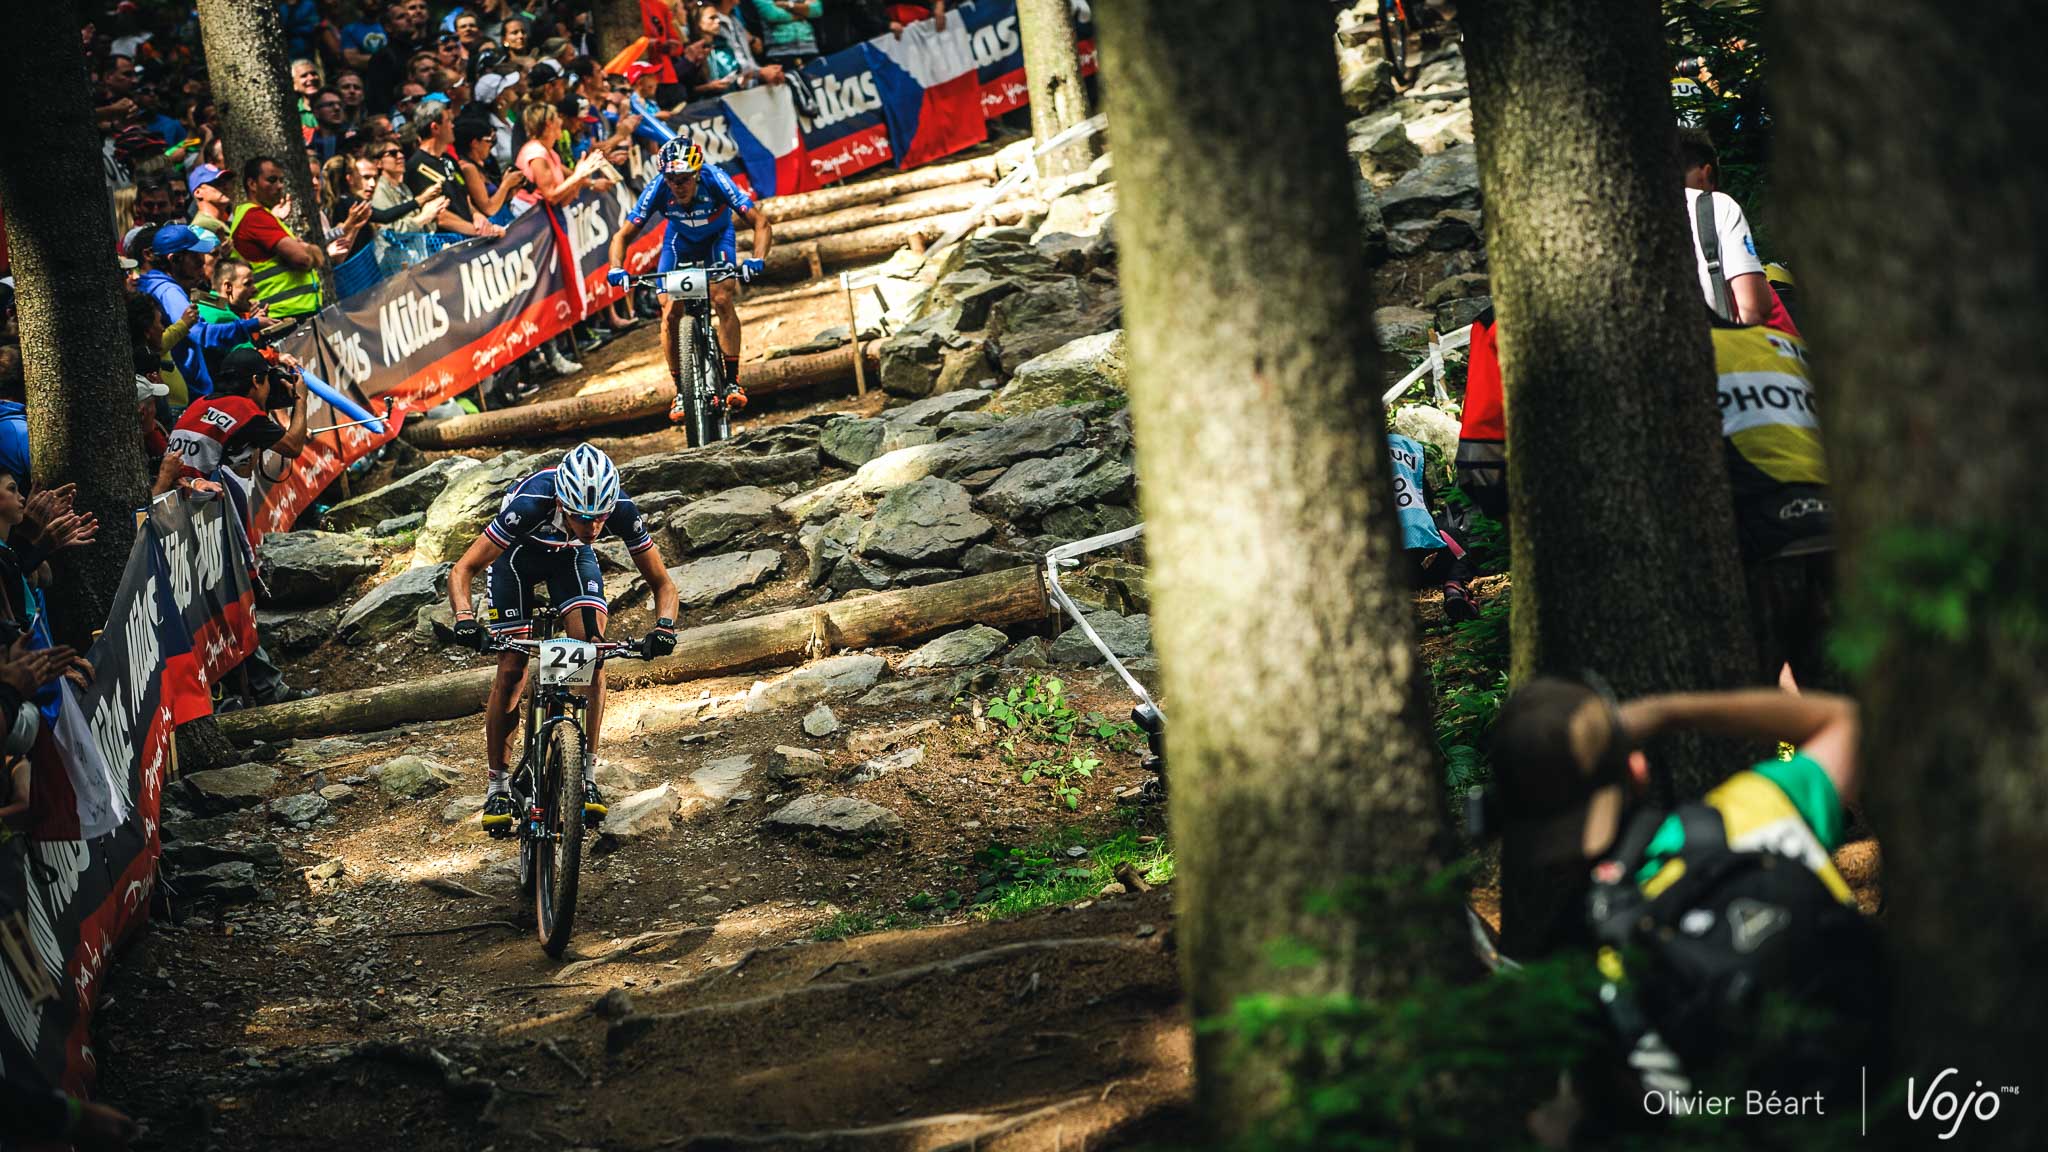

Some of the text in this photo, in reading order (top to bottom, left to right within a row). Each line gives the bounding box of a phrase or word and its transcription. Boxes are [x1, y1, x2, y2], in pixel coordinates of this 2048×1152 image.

[803, 71, 882, 132] itas
[680, 275, 694, 292] 6
[379, 288, 450, 368] Mitas
[459, 242, 537, 324] Mitas
[207, 410, 234, 429] UCI
[166, 437, 200, 456] HOTO
[550, 646, 588, 670] 24
